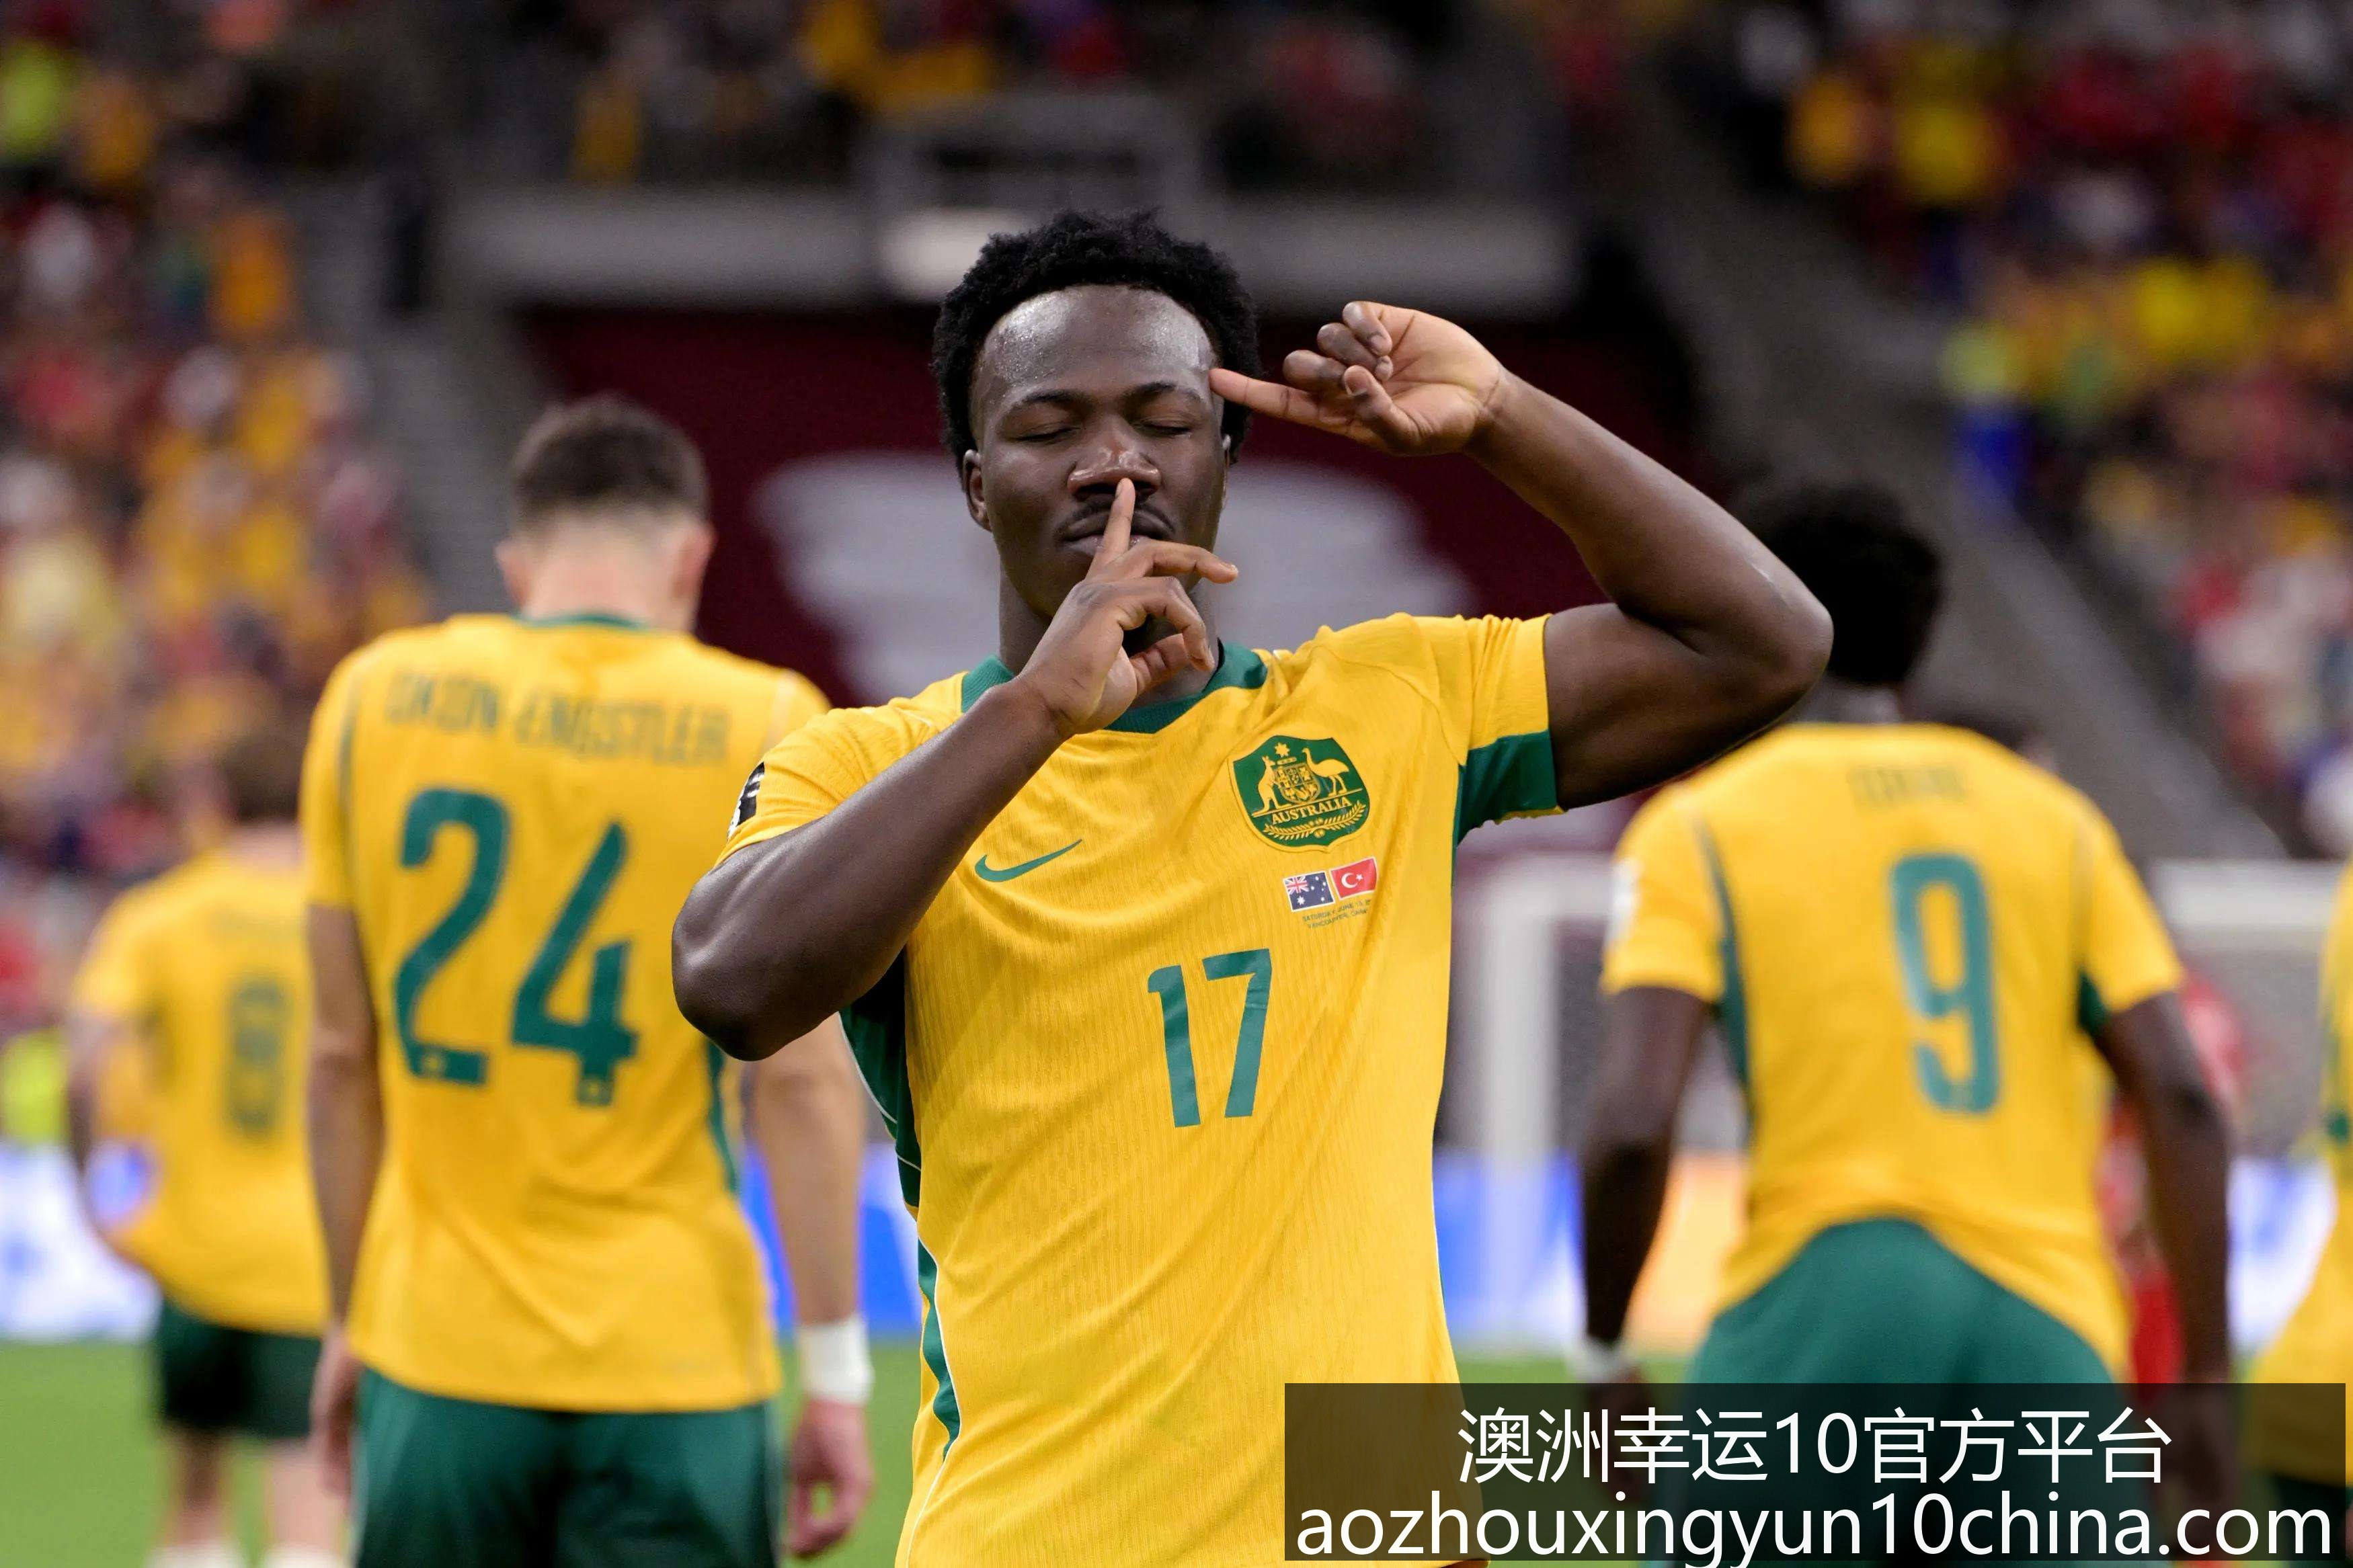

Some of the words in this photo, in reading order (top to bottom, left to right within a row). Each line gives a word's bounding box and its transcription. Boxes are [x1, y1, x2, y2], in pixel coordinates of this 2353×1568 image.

[1271, 796, 1352, 825] AUSTRALIA
[393, 788, 640, 1107] 24
[1147, 948, 1272, 1128] 17
[1889, 854, 2001, 1116] 9
